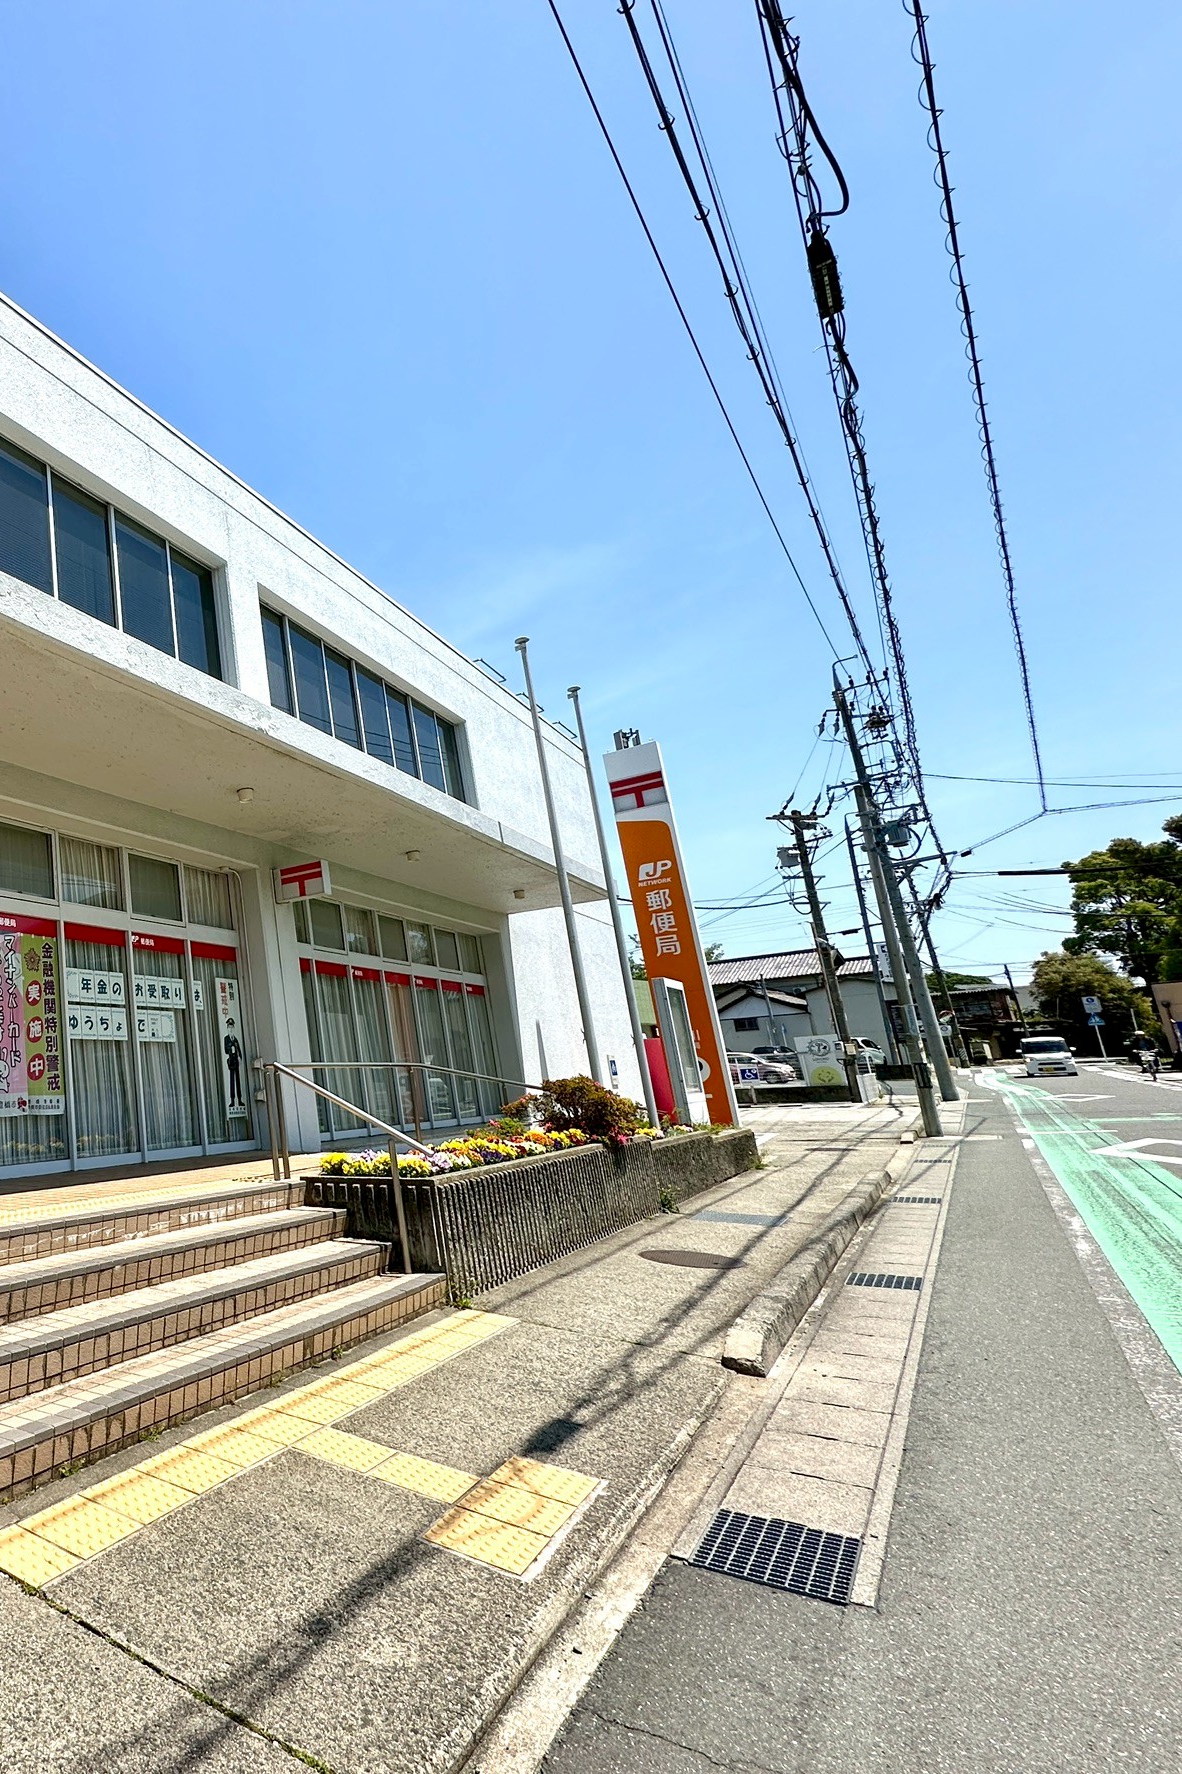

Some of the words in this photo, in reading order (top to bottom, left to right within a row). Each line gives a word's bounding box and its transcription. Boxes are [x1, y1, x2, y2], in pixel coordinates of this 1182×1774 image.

[638, 877, 672, 888] NETWORK
[646, 888, 681, 957] 郵便局
[4, 935, 21, 1067] マイナンバーカード
[27, 984, 44, 1077] 実施中
[41, 942, 61, 1091] 金融機関特別警戒
[219, 982, 229, 1018] 警戒中
